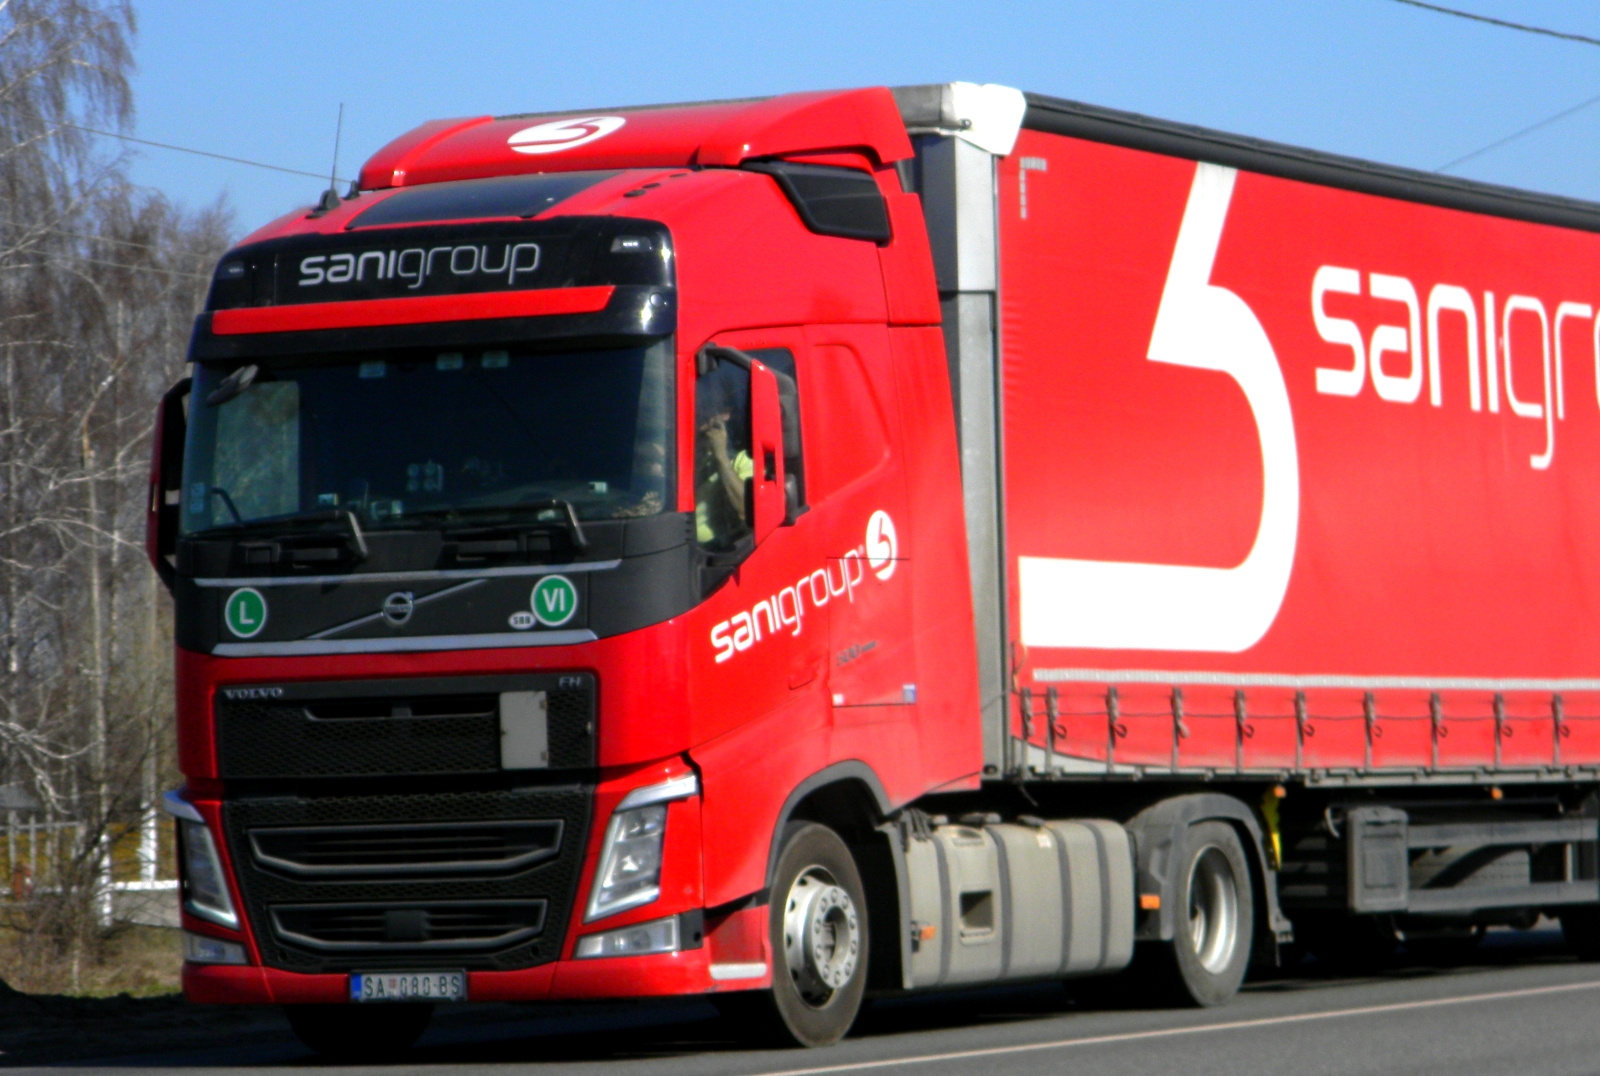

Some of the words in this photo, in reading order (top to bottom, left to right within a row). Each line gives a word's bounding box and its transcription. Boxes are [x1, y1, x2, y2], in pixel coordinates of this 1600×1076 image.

[298, 243, 541, 289] sanigroup
[1311, 264, 1600, 470] sanigr
[239, 600, 255, 625] L
[541, 587, 566, 613] VI
[710, 548, 862, 664] sanigroup
[224, 687, 283, 699] VOLVO
[559, 677, 581, 687] FH
[364, 976, 386, 997] SA
